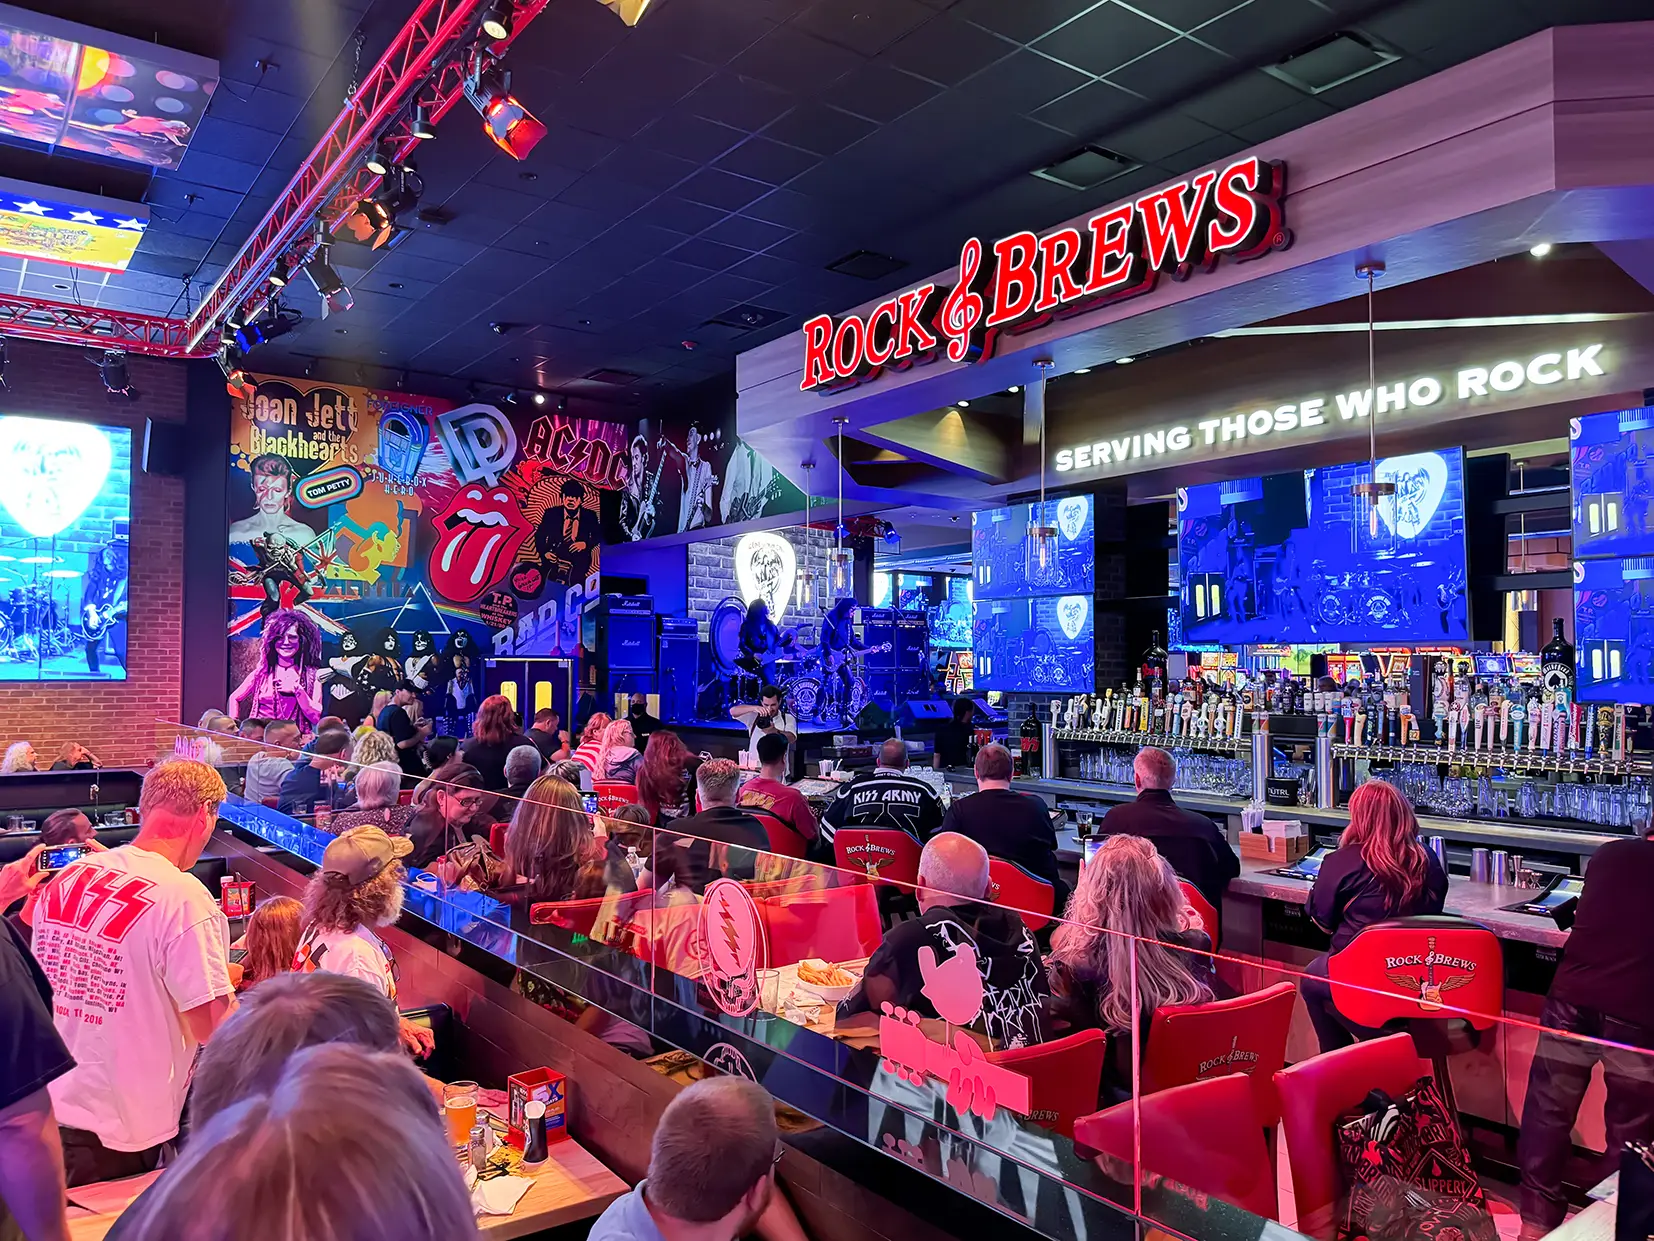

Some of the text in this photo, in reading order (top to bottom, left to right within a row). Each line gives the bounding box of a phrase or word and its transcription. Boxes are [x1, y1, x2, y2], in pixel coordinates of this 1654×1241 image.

[800, 284, 936, 391] ROCK
[986, 157, 1260, 327] BREWS
[240, 391, 358, 432] Joan Jett
[367, 400, 433, 416] FOREIGNER
[1055, 344, 1606, 472] SERVING THOSE WHO ROCK
[250, 424, 359, 464] Blackhearts
[313, 430, 340, 442] and the
[307, 478, 350, 497] TOM PETTY
[492, 592, 513, 607] T.P.
[481, 613, 512, 625] WHISKEY
[853, 789, 922, 804] KISS ARMY
[846, 845, 865, 855] ROCK
[870, 844, 896, 856] BREWS
[43, 862, 157, 944] KISS
[1385, 954, 1422, 969] ROCK
[1434, 953, 1477, 971] BREWS
[84, 1013, 103, 1025] 2016
[1200, 1054, 1226, 1073] ROCK
[1233, 1050, 1260, 1062] BREWS
[1415, 1178, 1467, 1195] SLIPPERY
